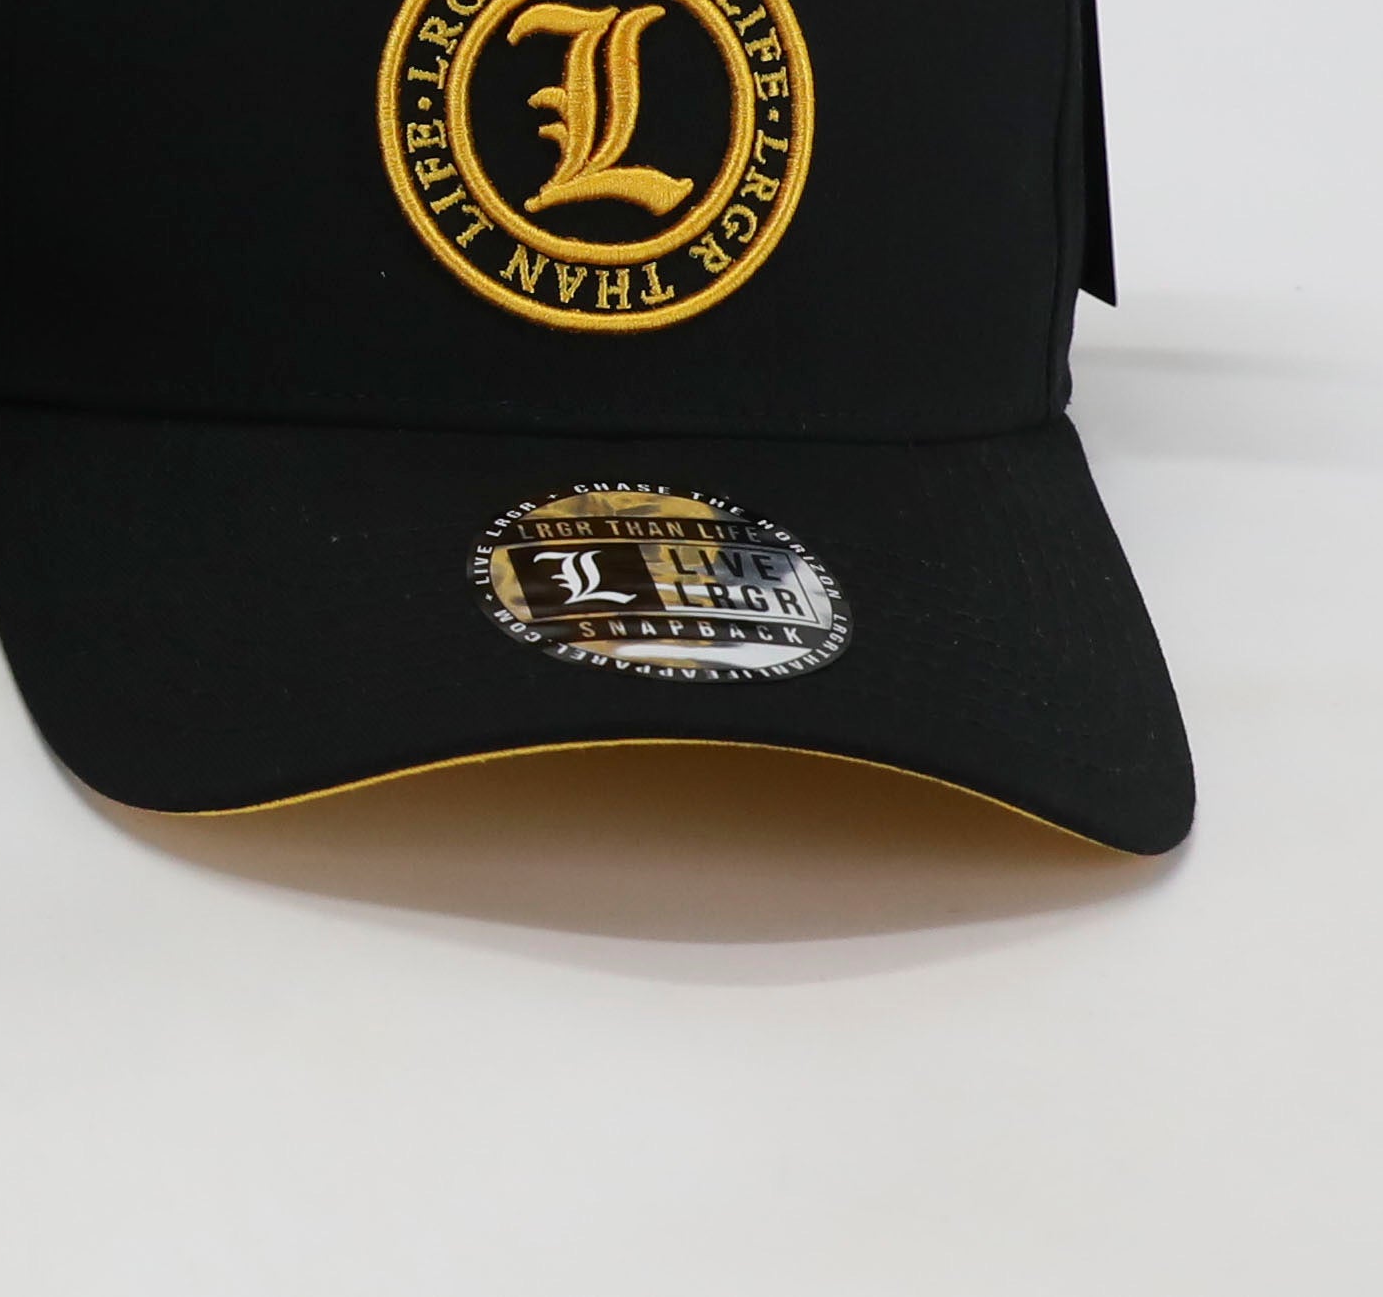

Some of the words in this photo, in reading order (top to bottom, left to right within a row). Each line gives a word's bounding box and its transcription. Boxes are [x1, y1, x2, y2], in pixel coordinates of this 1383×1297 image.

[506, 3, 695, 216] L
[406, 117, 496, 249] LIFE
[688, 130, 790, 275] LRGR
[499, 243, 676, 311] THAN
[473, 544, 494, 585] LIVE
[486, 502, 537, 539] LRGR
[573, 482, 671, 495] CHASE
[690, 491, 745, 517] THE
[757, 519, 842, 600] HORIZON
[517, 521, 594, 540] LRGR
[604, 520, 685, 538] THAN
[696, 523, 762, 543] LIFE
[533, 550, 637, 604] L
[668, 548, 782, 582] LIVE
[674, 581, 806, 617] LRGR
[578, 619, 803, 644] SNAPBACK
